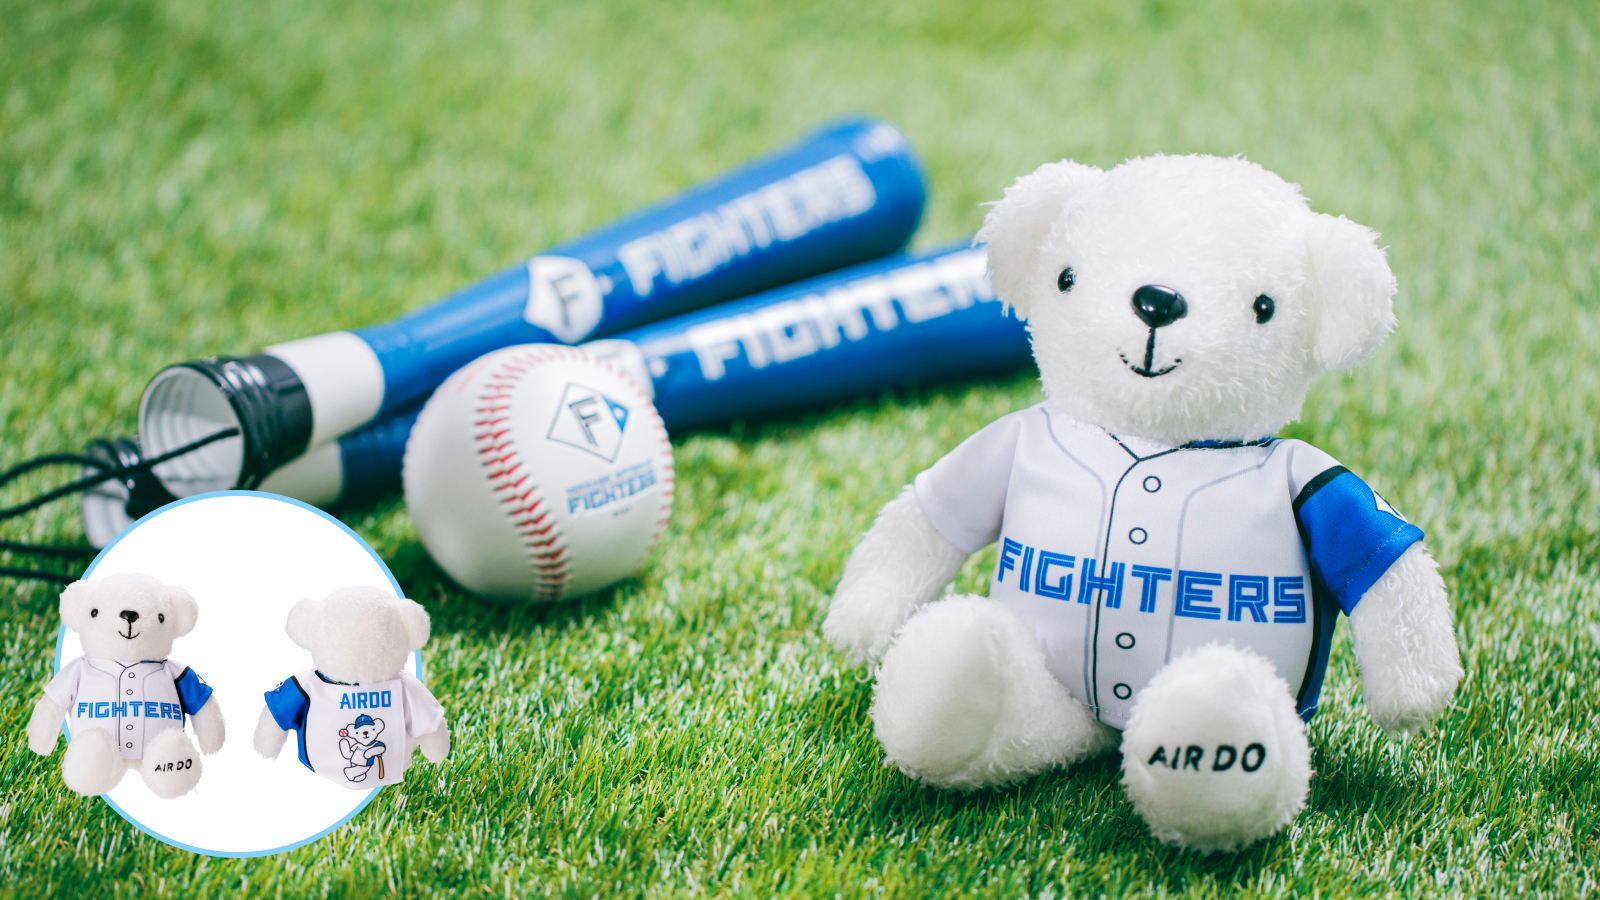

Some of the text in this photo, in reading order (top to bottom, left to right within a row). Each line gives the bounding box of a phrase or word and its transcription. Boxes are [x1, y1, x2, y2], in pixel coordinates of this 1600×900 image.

[617, 152, 877, 297] FIGHTERS
[688, 246, 998, 381] FIGHTER
[568, 396, 601, 448] F
[567, 469, 657, 515] FIGHTERS
[997, 536, 1307, 624] FIGHTERS
[77, 701, 182, 721] FIGHTERS
[339, 690, 392, 710] AIRDO
